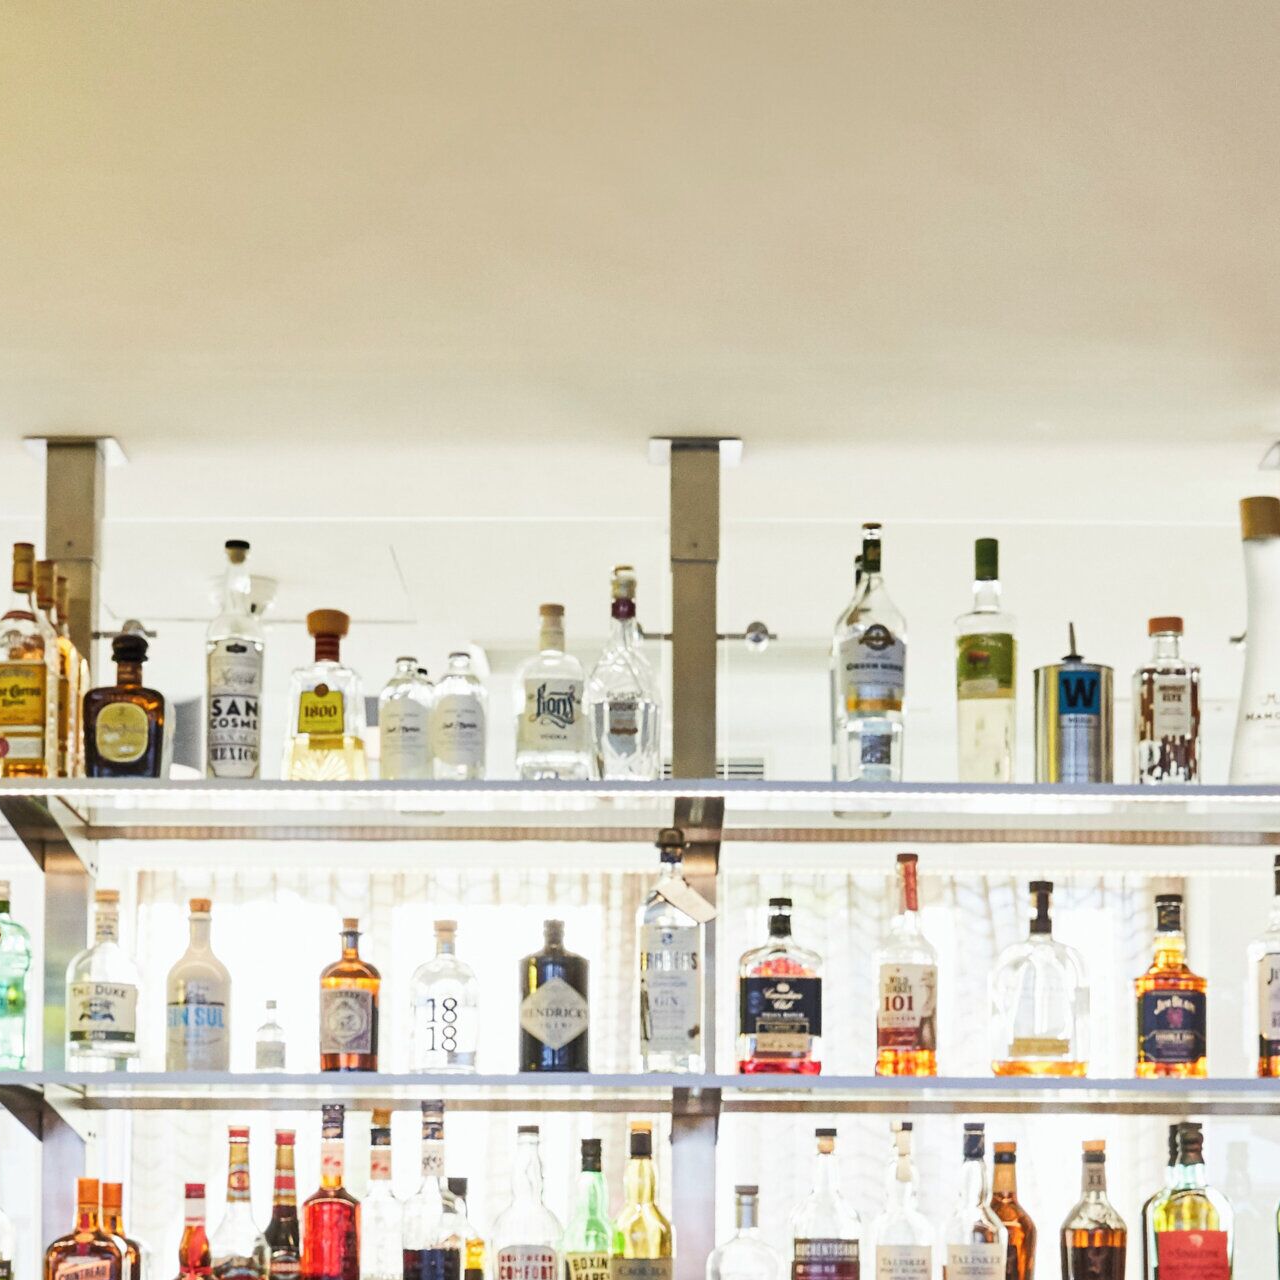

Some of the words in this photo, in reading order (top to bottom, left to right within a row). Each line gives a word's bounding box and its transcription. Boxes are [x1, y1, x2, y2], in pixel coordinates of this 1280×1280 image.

[1062, 677, 1098, 708] W
[211, 698, 258, 718] SAN
[304, 705, 338, 719] 1800
[426, 998, 458, 1024] 18
[884, 996, 914, 1011] 101
[195, 1006, 224, 1028] SUL
[426, 1026, 458, 1052] 18
[500, 1266, 554, 1280] COMFORT
[573, 1256, 609, 1271] BOXIN
